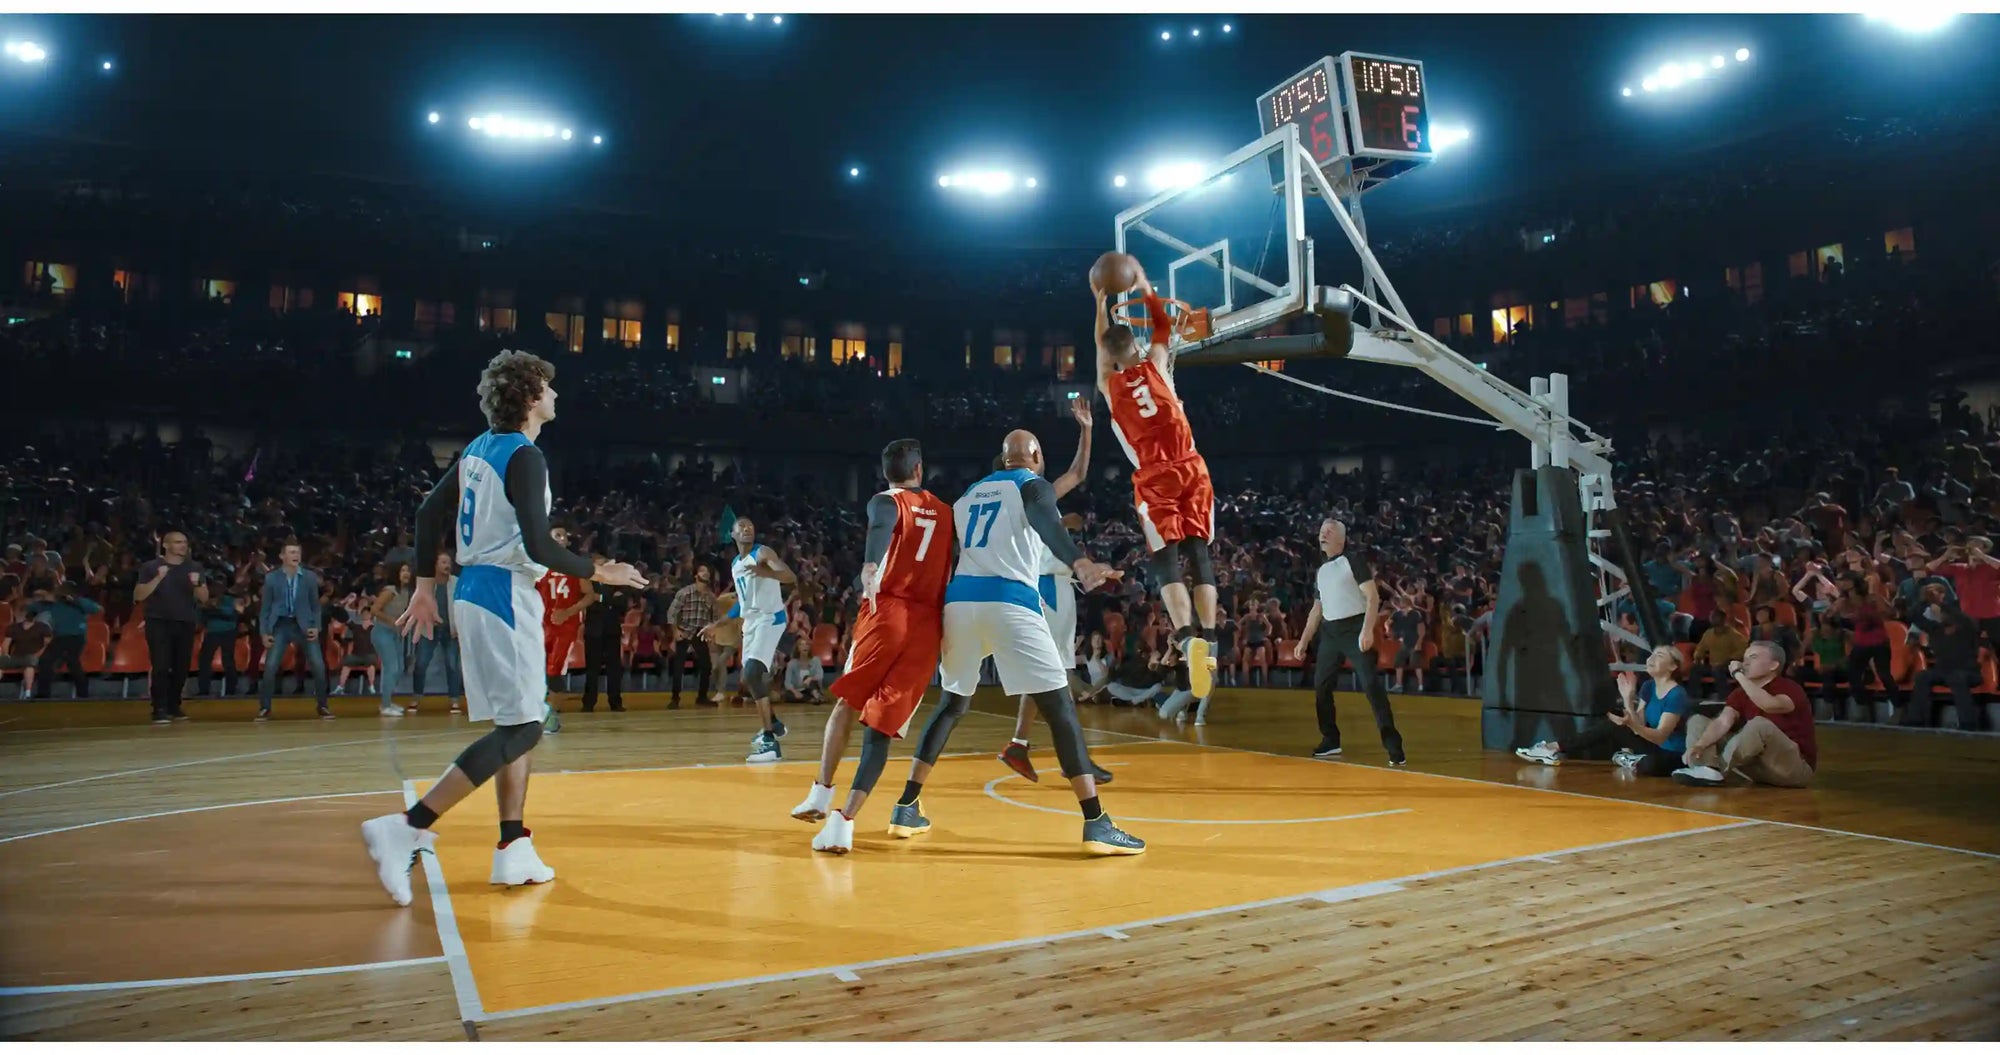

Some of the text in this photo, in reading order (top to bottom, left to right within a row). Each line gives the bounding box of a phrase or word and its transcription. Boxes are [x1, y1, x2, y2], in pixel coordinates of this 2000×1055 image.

[1310, 112, 1333, 160] 6
[1400, 105, 1421, 149] 6
[1132, 384, 1158, 418] 3
[915, 517, 937, 562] 7
[964, 500, 1002, 549] 17
[548, 576, 570, 600] 14
